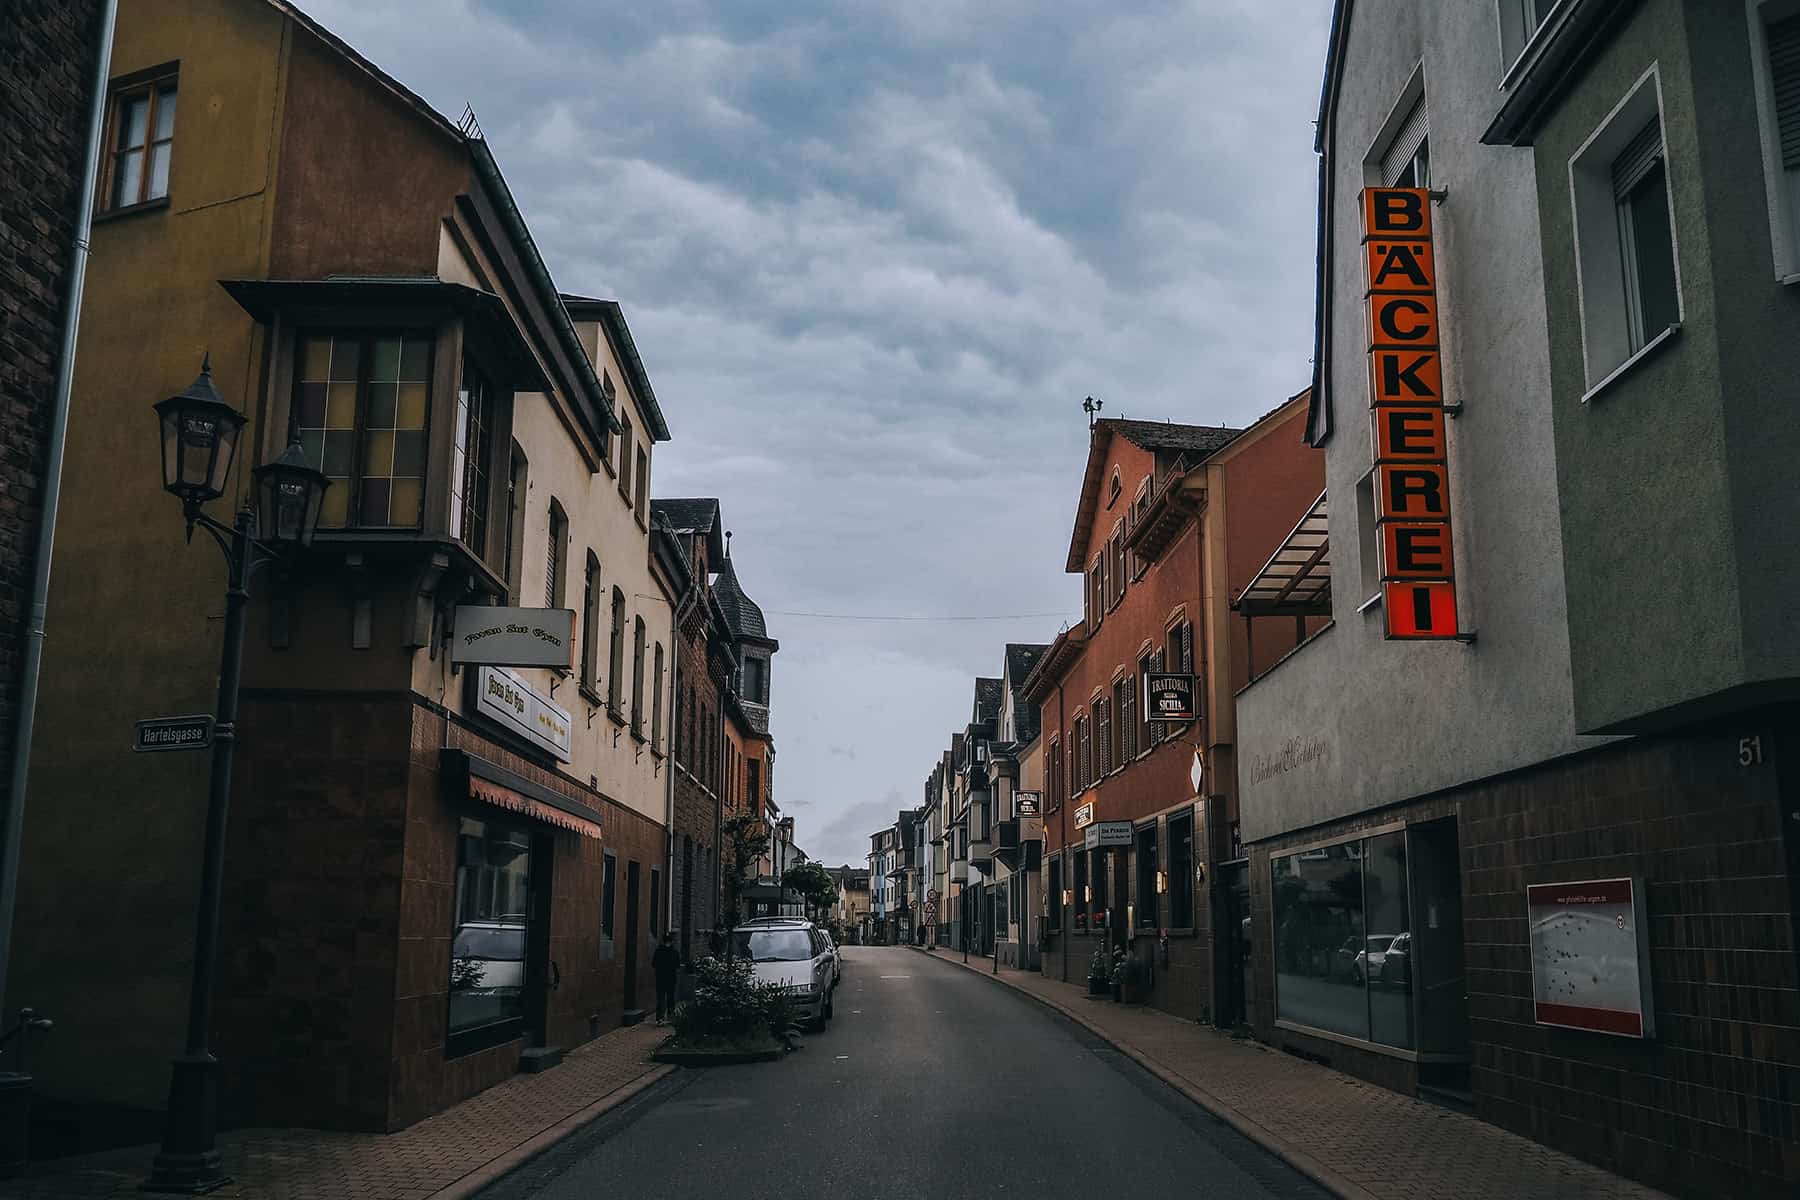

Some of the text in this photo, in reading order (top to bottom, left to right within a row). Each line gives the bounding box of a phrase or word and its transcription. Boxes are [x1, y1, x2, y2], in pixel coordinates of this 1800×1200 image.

[1374, 190, 1443, 632] BÄCKEREI
[1151, 678, 1189, 693] TRATTORIA
[1739, 735, 1762, 768] 51
